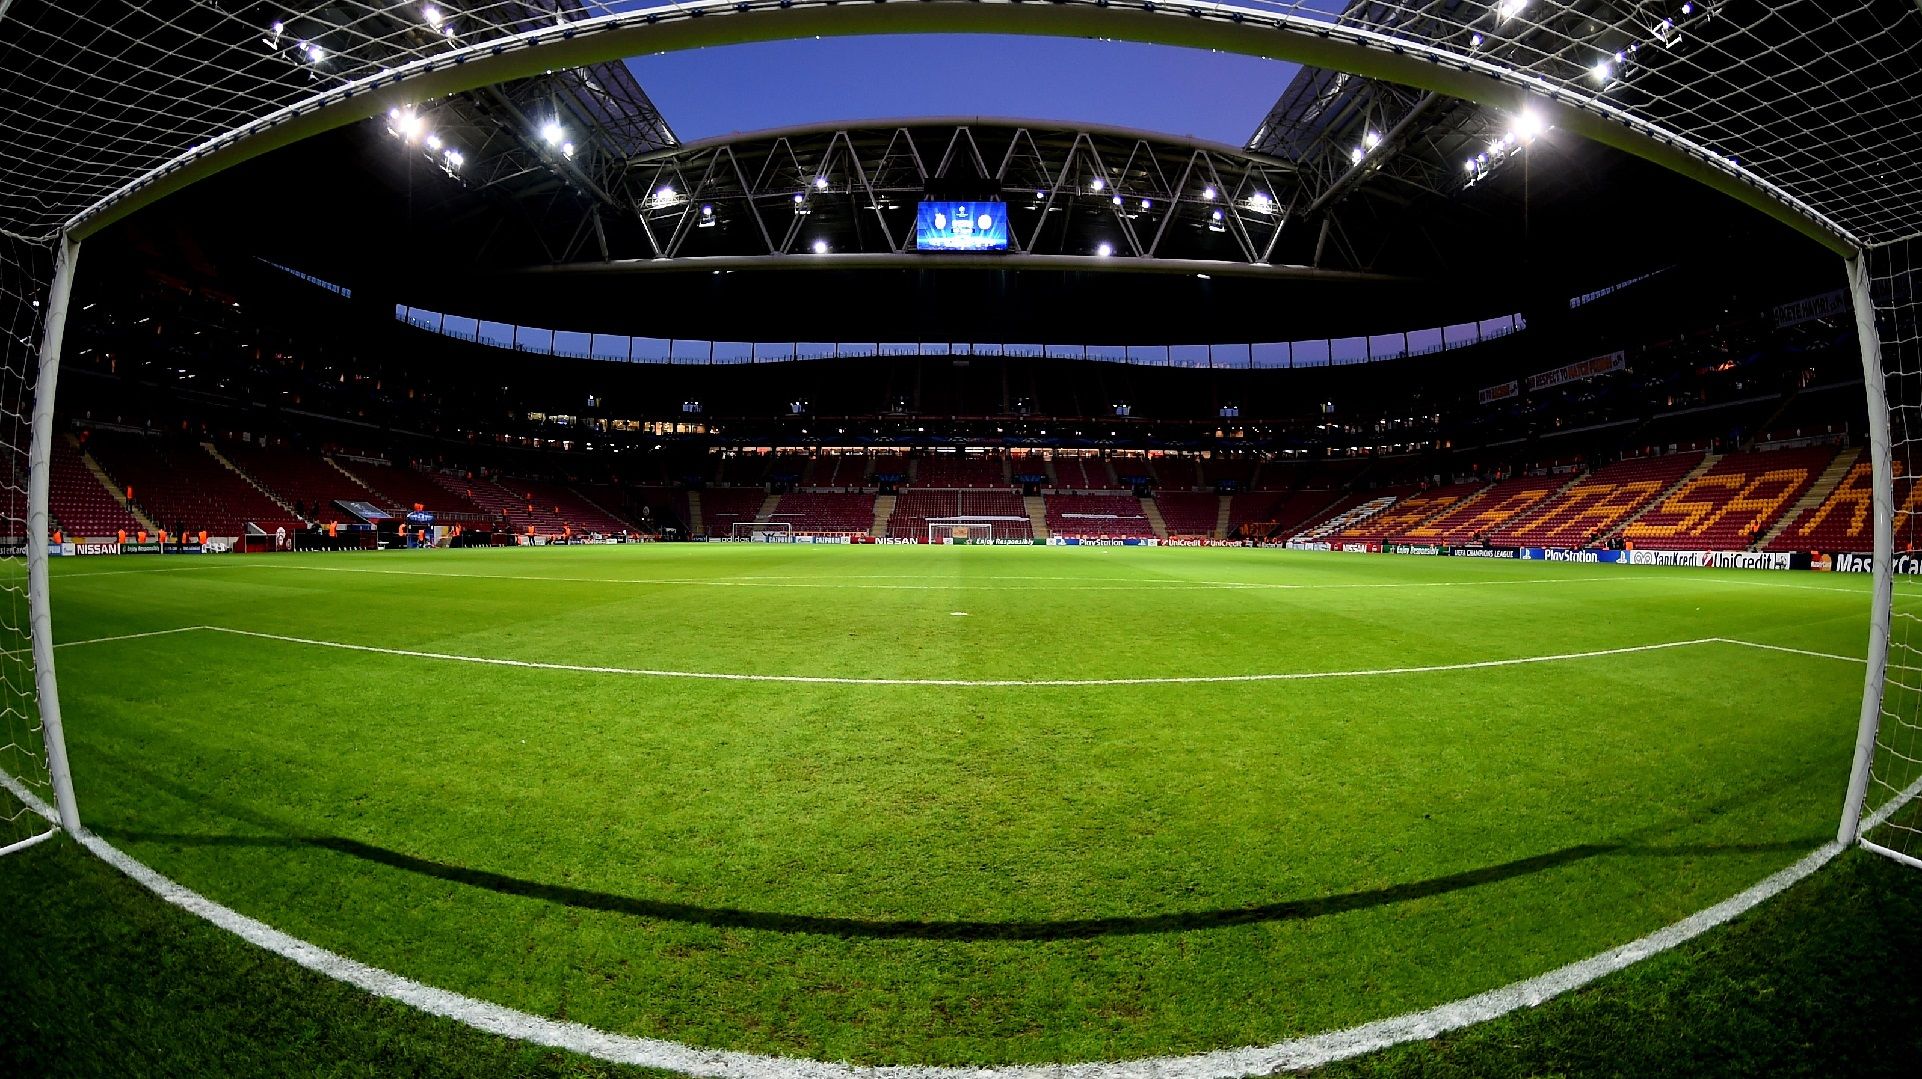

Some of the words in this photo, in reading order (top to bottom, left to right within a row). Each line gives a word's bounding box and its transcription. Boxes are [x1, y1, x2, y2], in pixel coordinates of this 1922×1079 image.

[1168, 538, 1200, 546] UniCredit
[1210, 539, 1242, 547] UniCredit
[77, 544, 117, 555] NISSAN
[1342, 544, 1367, 553] NISSAN
[1396, 545, 1410, 554] Enjoy
[1410, 545, 1439, 556] Responsibly
[1454, 549, 1466, 557] UEFA
[1466, 549, 1494, 558] CHAMPIONS
[1494, 550, 1514, 558] LEAGUE
[1545, 549, 1599, 562] PlayStation
[1714, 552, 1772, 570] UniCredit
